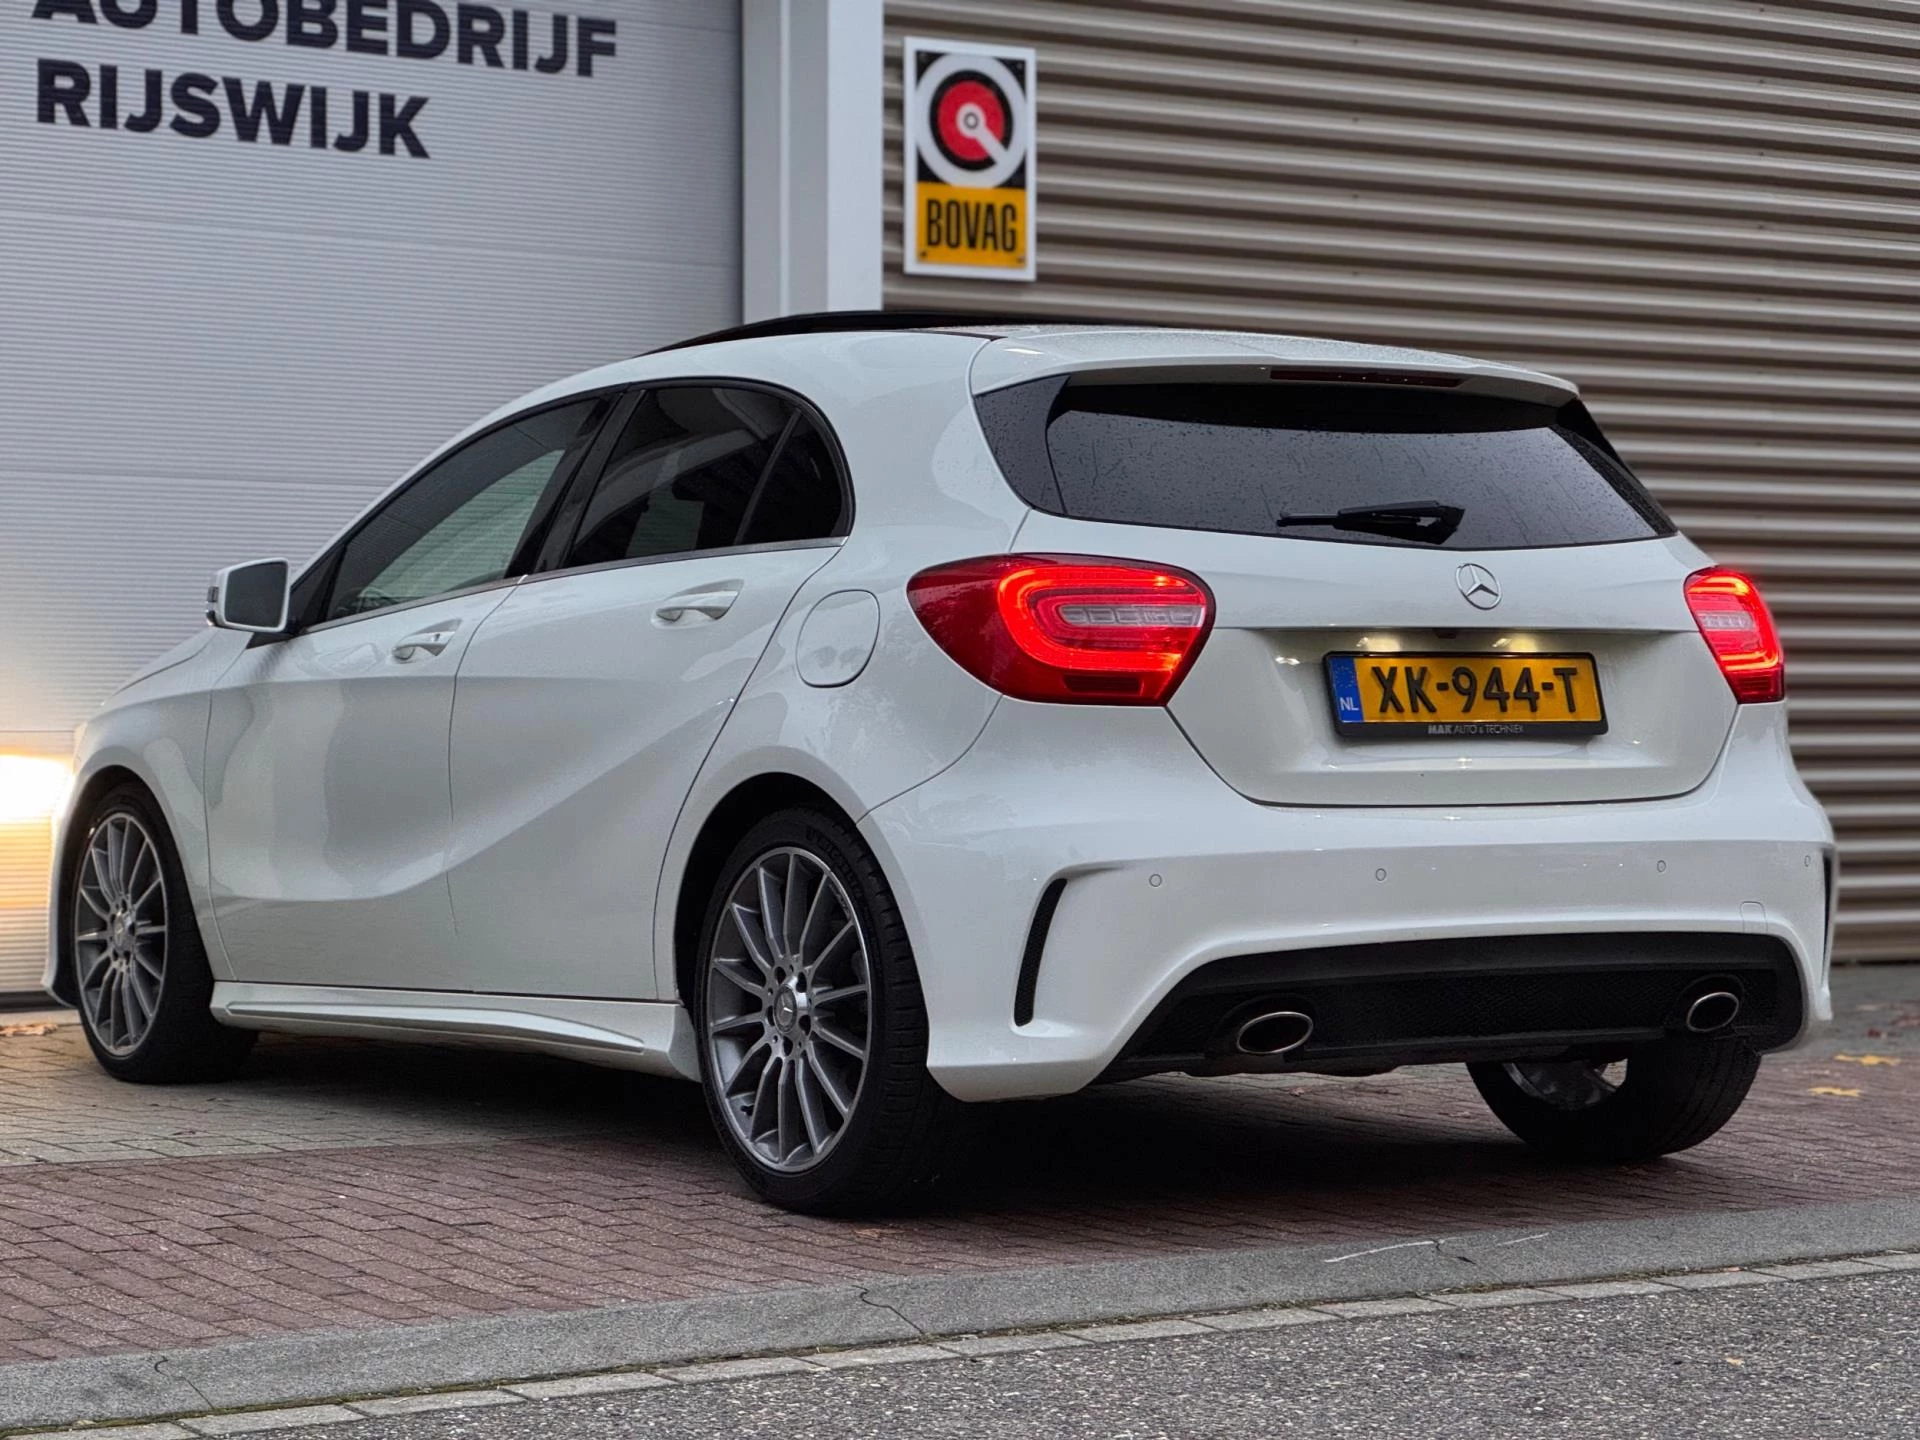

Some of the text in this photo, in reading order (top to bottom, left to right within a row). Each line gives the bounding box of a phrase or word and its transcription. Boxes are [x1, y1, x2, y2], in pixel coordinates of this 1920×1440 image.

[31, 0, 617, 77] OBEDRIJF
[37, 58, 430, 159] RIJSWIJK
[926, 198, 1017, 252] BOVAG
[1340, 697, 1359, 711] NL
[1371, 666, 1578, 713] XK-944-T
[1453, 724, 1477, 734] AUTO
